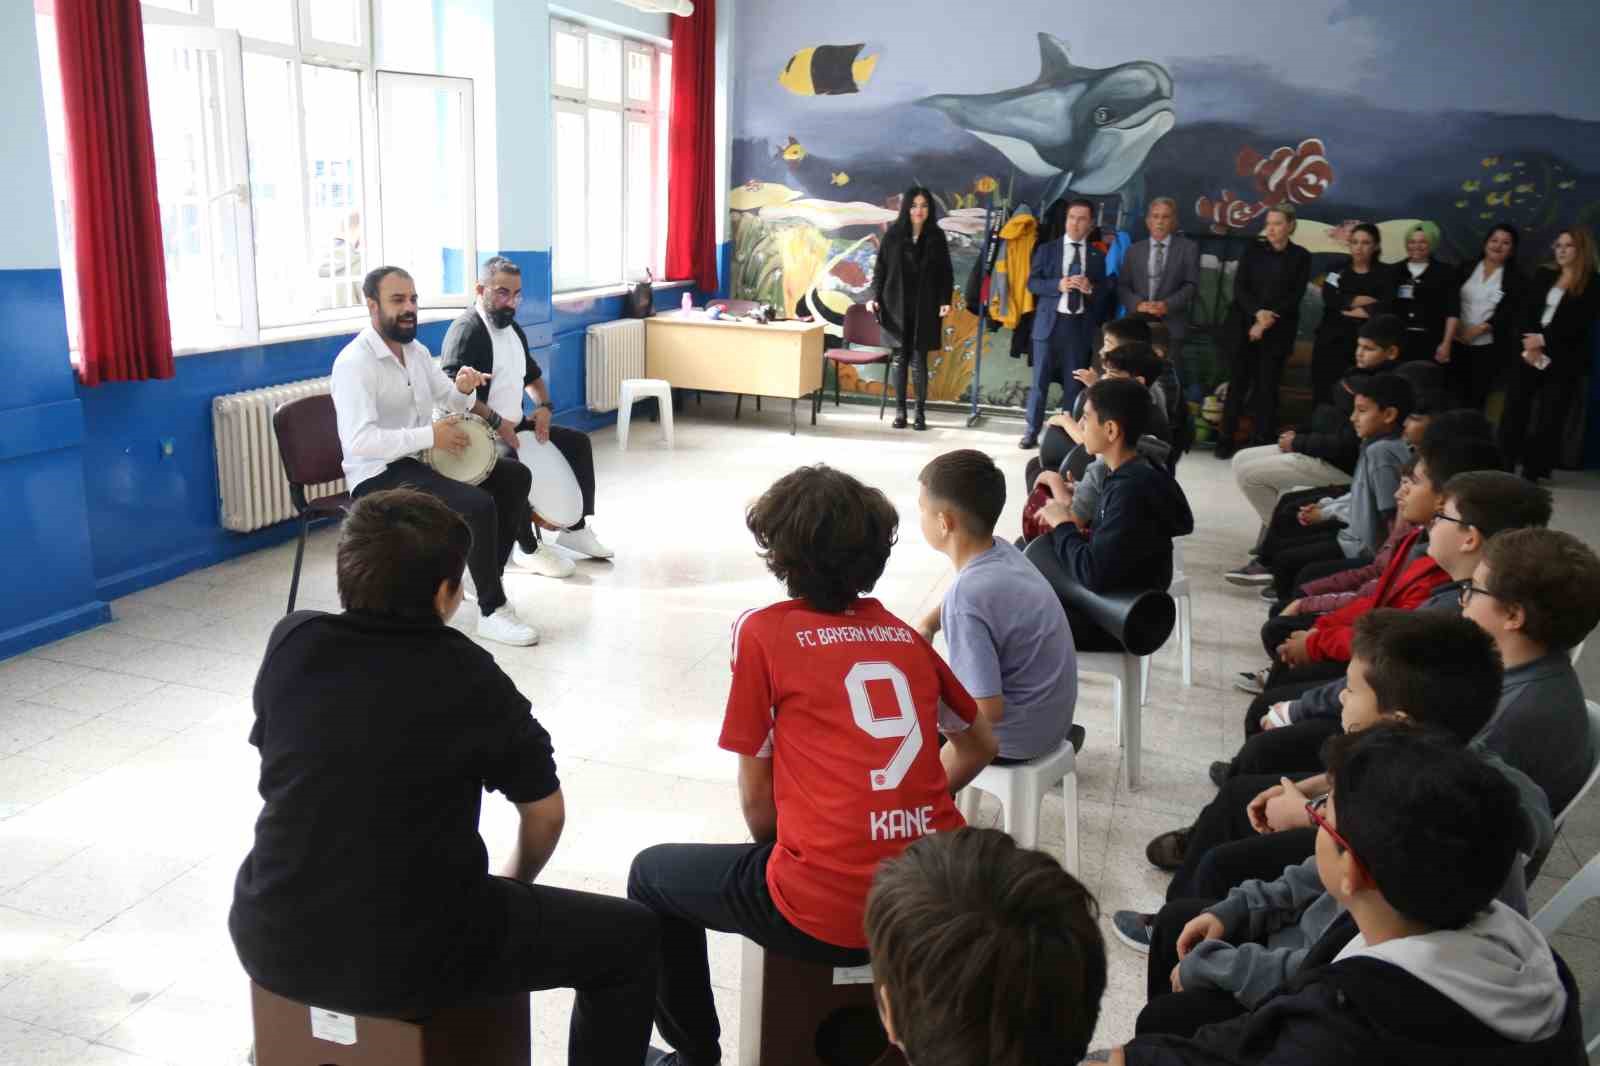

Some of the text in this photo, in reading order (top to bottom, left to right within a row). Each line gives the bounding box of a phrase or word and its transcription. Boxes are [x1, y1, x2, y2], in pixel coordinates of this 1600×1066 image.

[796, 630, 816, 647] FC
[817, 626, 867, 645] BAYERN
[844, 660, 923, 791] 9
[870, 806, 936, 840] KANE
